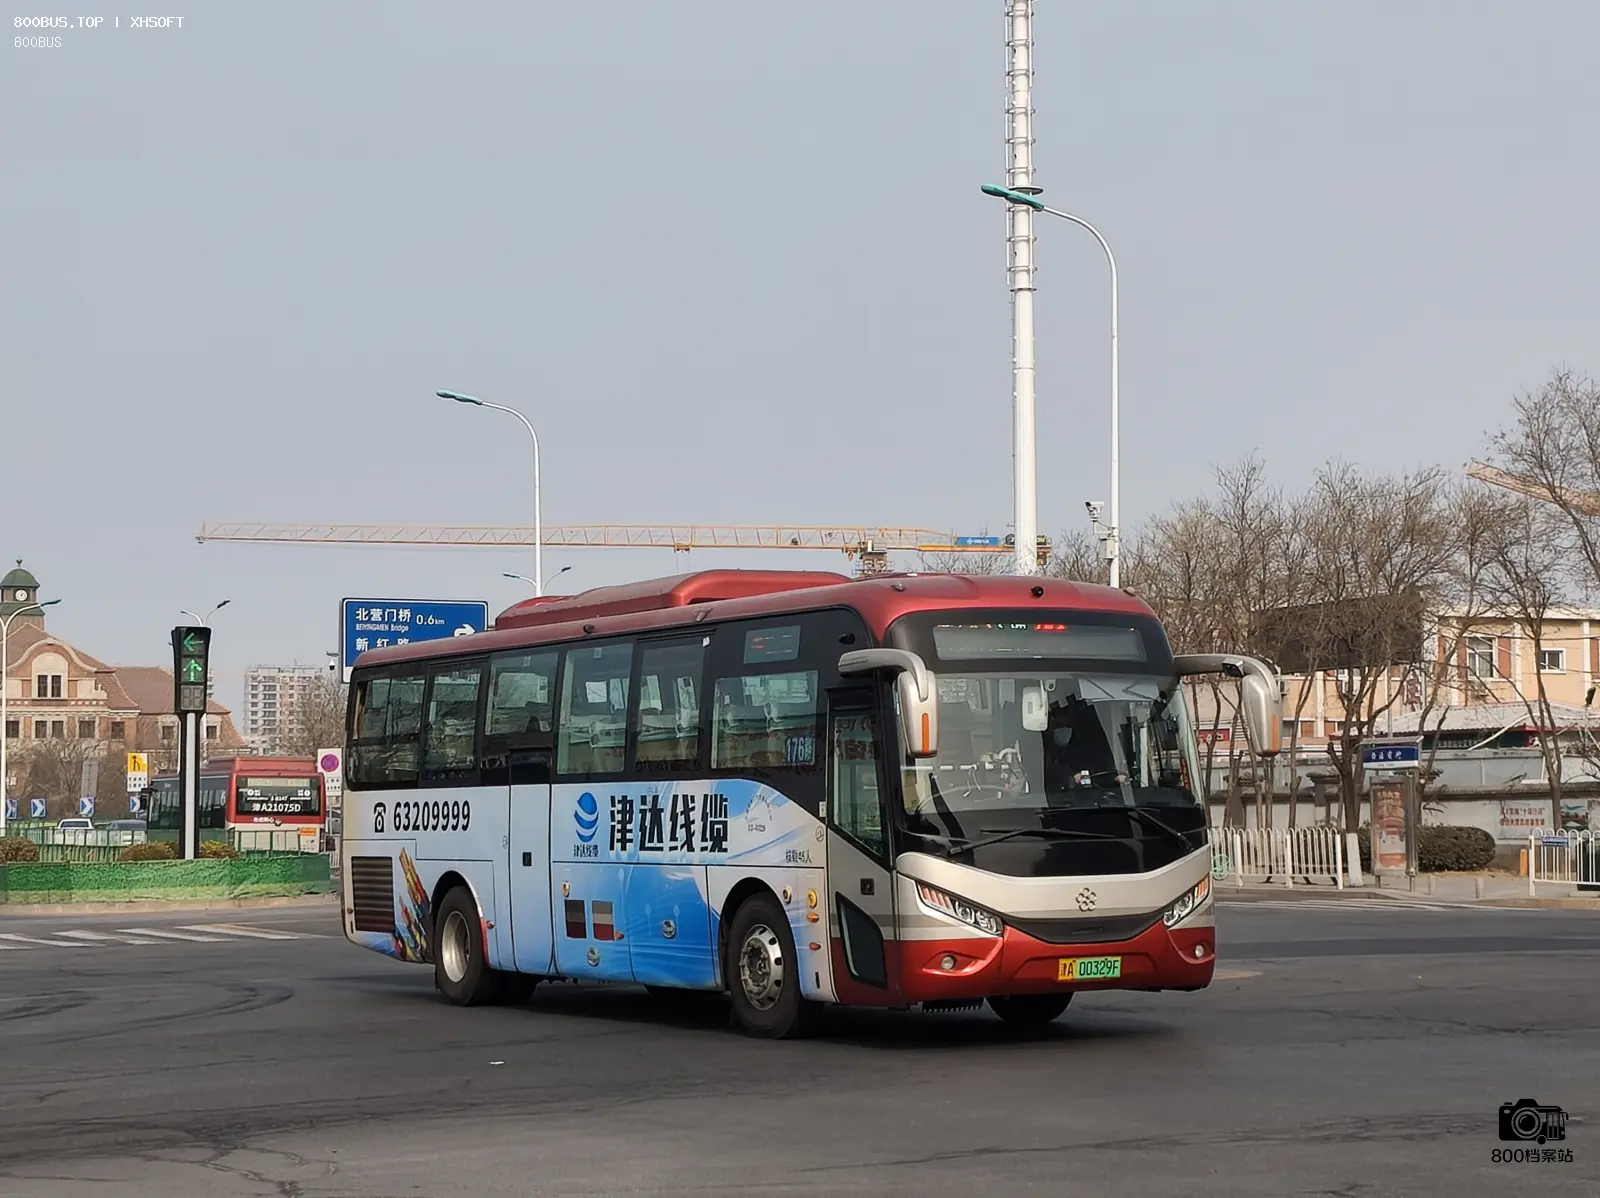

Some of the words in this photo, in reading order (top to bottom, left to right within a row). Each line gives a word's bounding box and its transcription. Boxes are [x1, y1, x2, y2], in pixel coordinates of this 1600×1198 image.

[355, 607, 411, 622] 北营门桥
[416, 614, 445, 625] 0.6km
[390, 623, 409, 633] Bridge
[393, 800, 470, 832] 63209999
[609, 793, 729, 853] 津达线缆
[1079, 960, 1119, 976] 00329F
